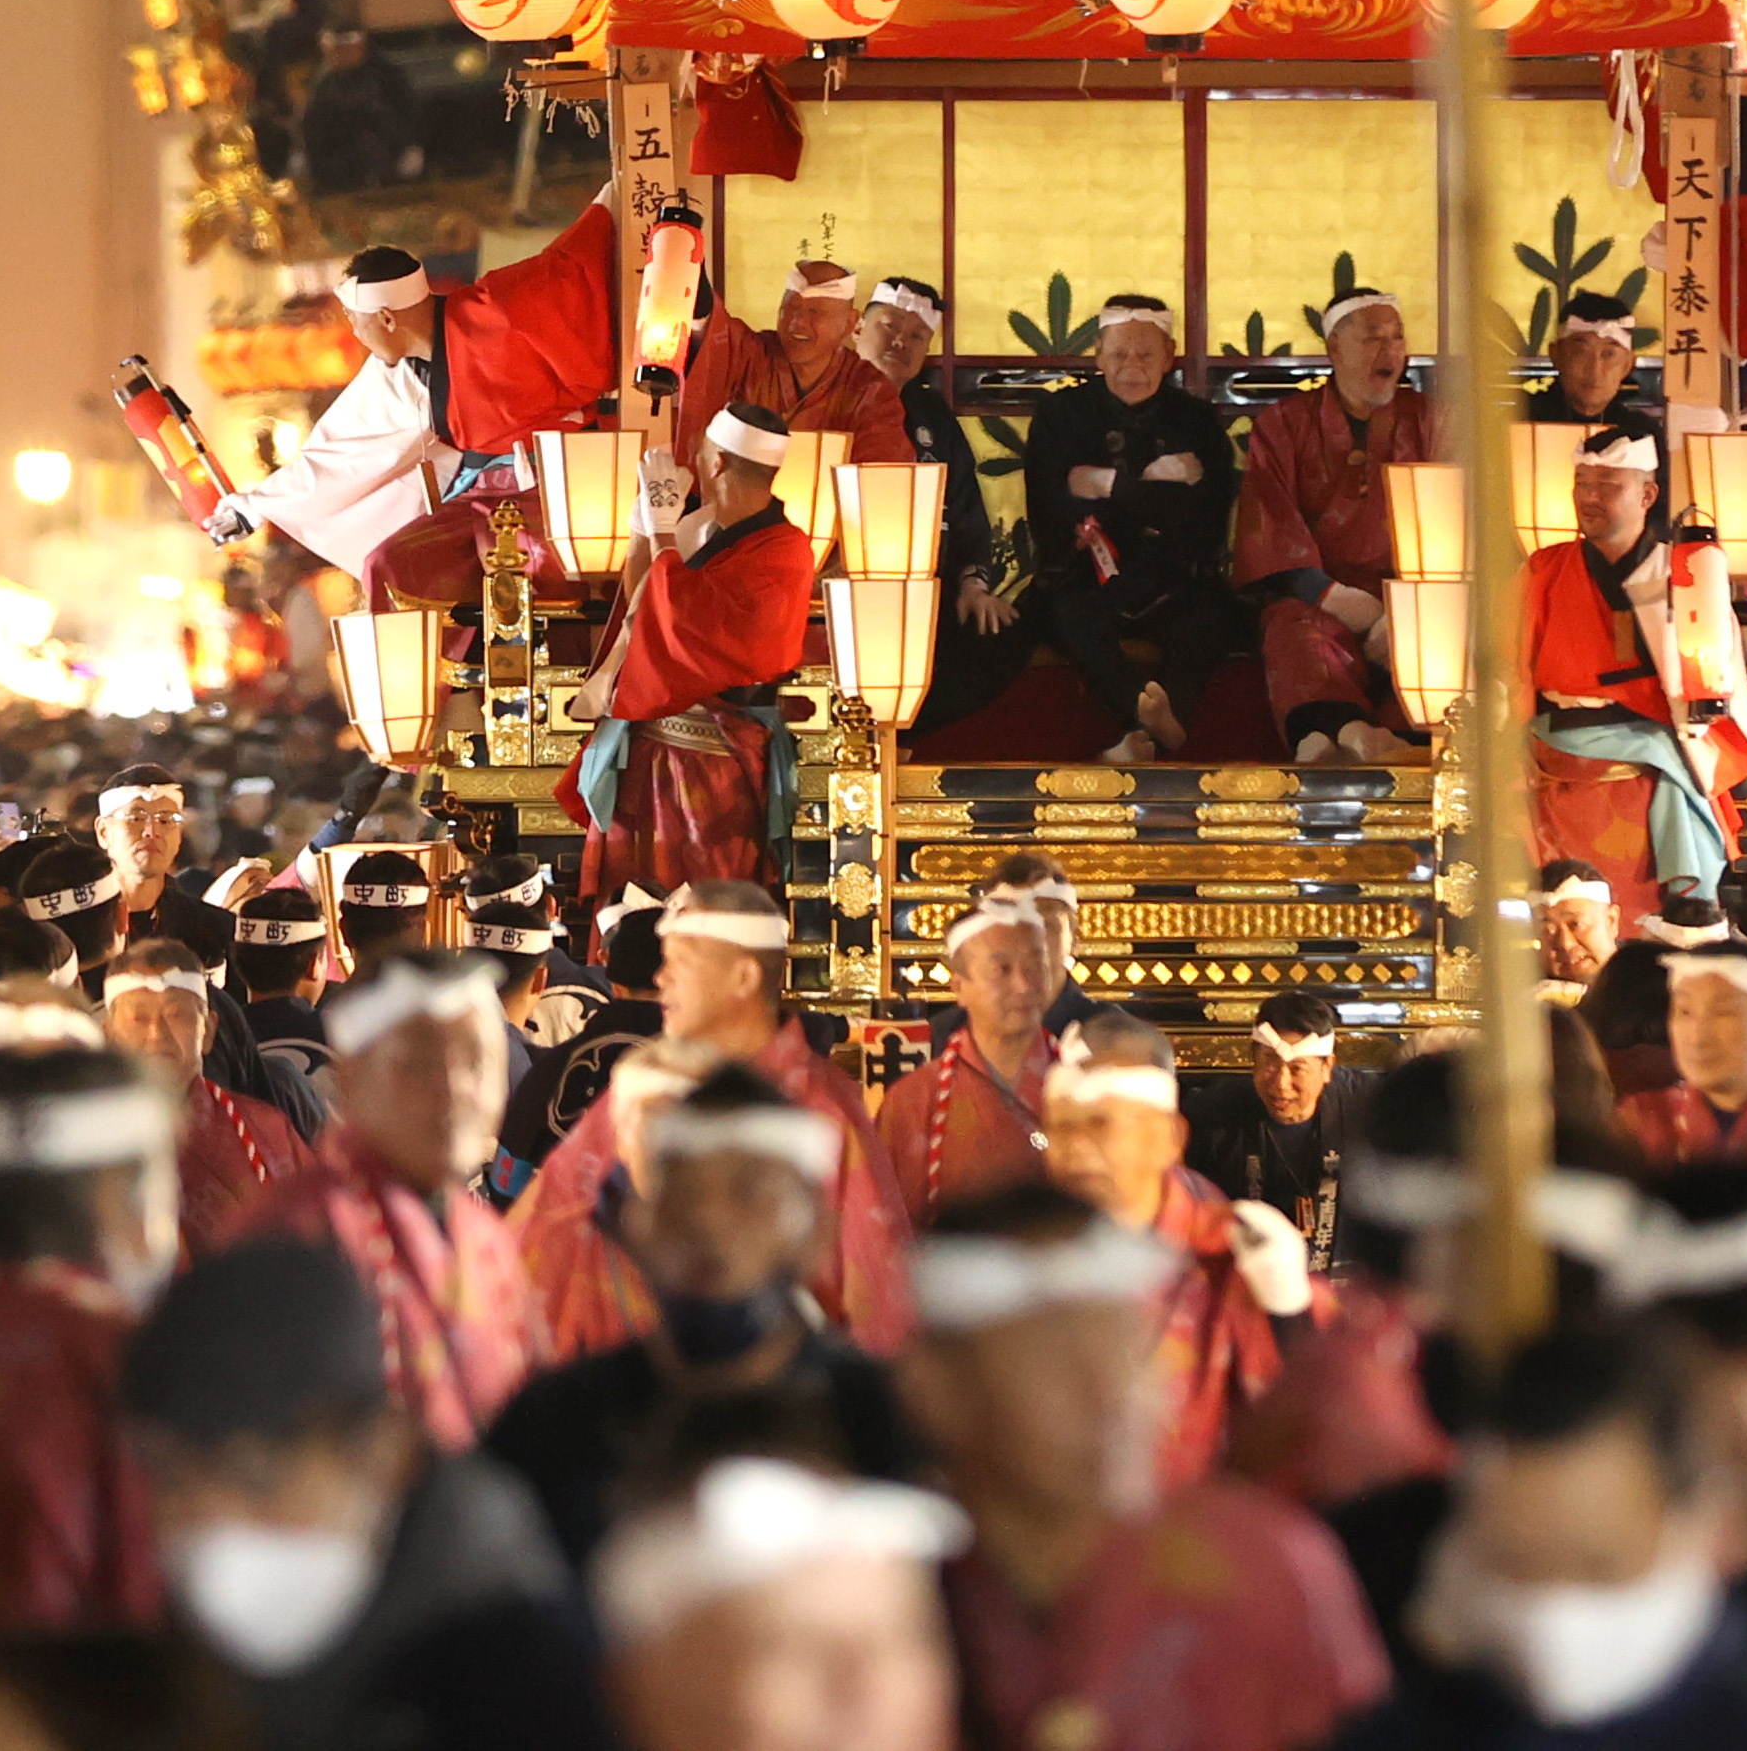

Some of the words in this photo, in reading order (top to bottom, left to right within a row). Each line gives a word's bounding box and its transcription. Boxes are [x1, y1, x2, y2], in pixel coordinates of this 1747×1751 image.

[629, 127, 670, 274] 五穀
[1668, 159, 1713, 390] 天下泰平
